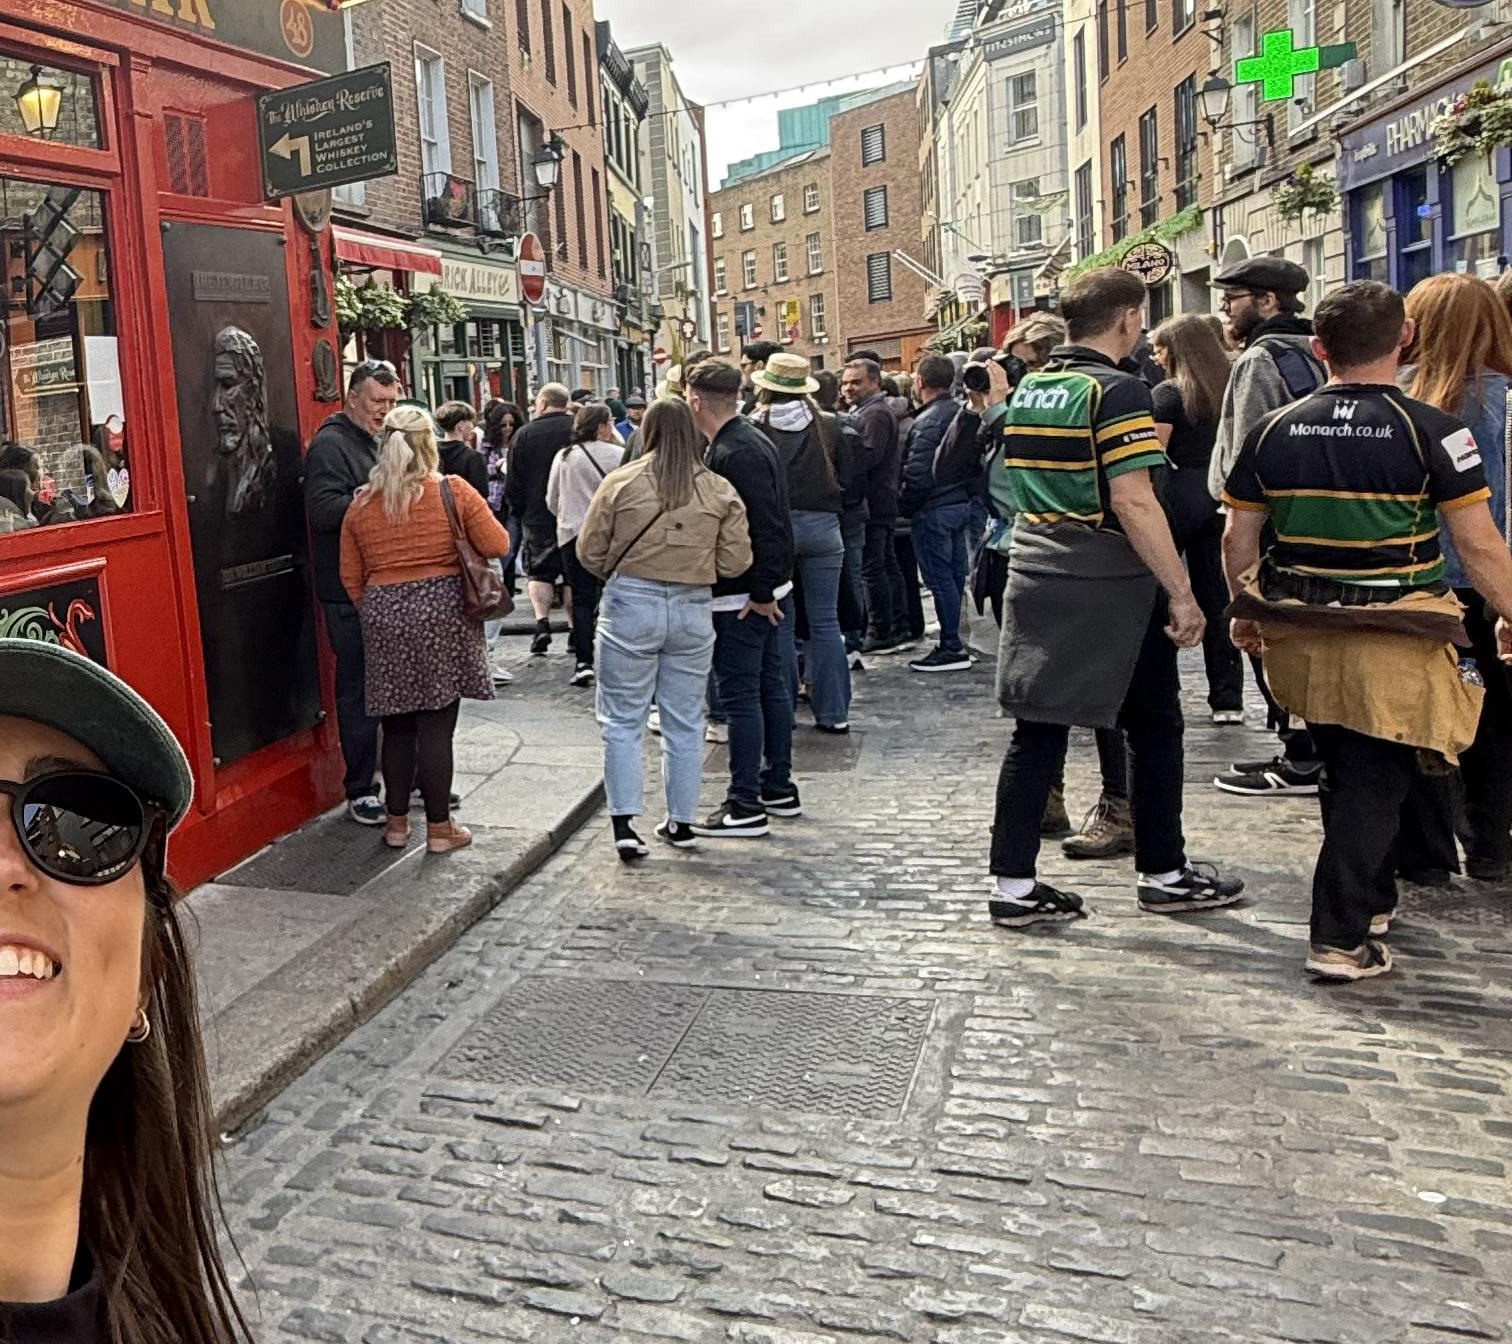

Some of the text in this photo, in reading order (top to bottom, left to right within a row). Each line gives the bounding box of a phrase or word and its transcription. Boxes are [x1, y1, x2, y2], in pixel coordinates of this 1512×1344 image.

[336, 82, 385, 111] Reserve
[313, 119, 374, 141] IRELAND'S
[1386, 92, 1456, 157] PHARMAC
[314, 133, 366, 152] LARGEST
[315, 144, 369, 163] WHISKEY
[315, 150, 388, 173] COLLECTION
[441, 264, 469, 293] RICK
[1013, 379, 1070, 410] cinch
[1289, 422, 1395, 440] Monarch.co.uk
